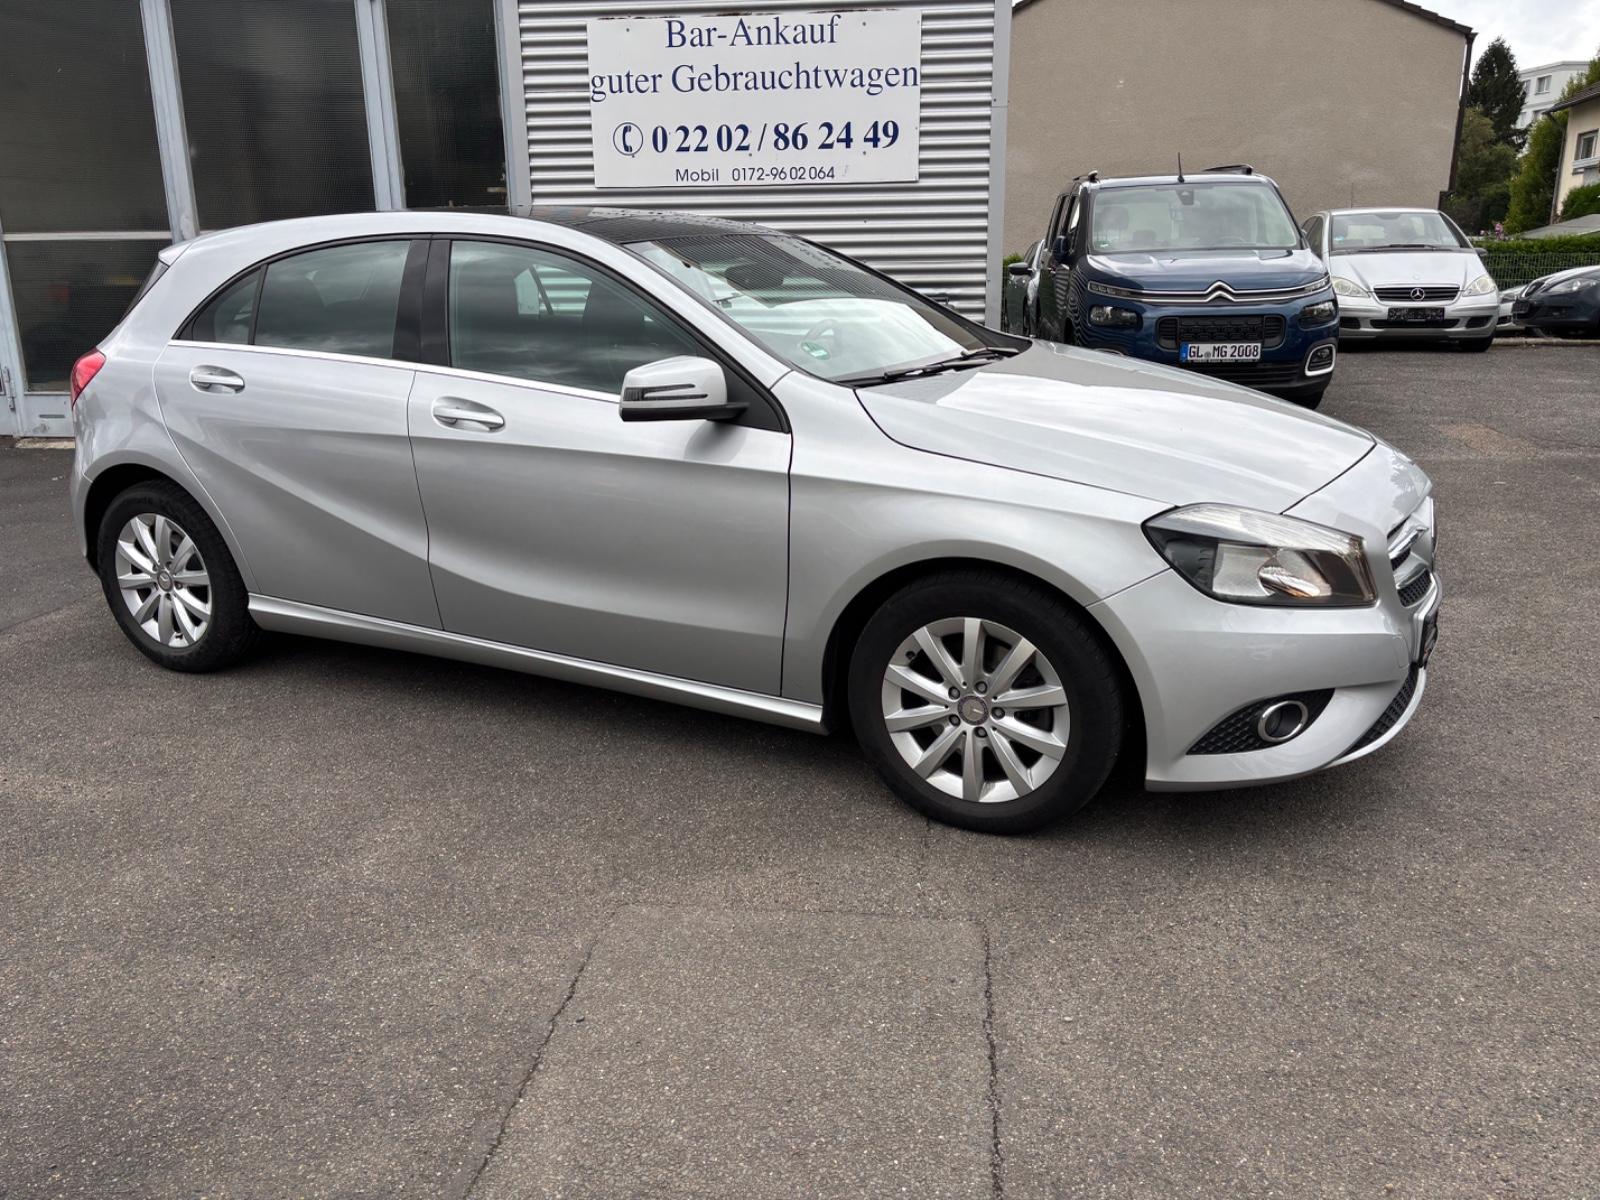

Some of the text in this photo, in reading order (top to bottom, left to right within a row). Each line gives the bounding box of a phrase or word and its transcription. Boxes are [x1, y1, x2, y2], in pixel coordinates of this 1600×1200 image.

[665, 14, 841, 49] Bar-Ankauf
[590, 61, 919, 103] guter Gebrauchtwagen
[817, 120, 854, 150] 24
[863, 119, 900, 149] 49
[675, 168, 719, 182] Mobil
[1188, 345, 1204, 359] GL
[1230, 344, 1259, 358] 2008
